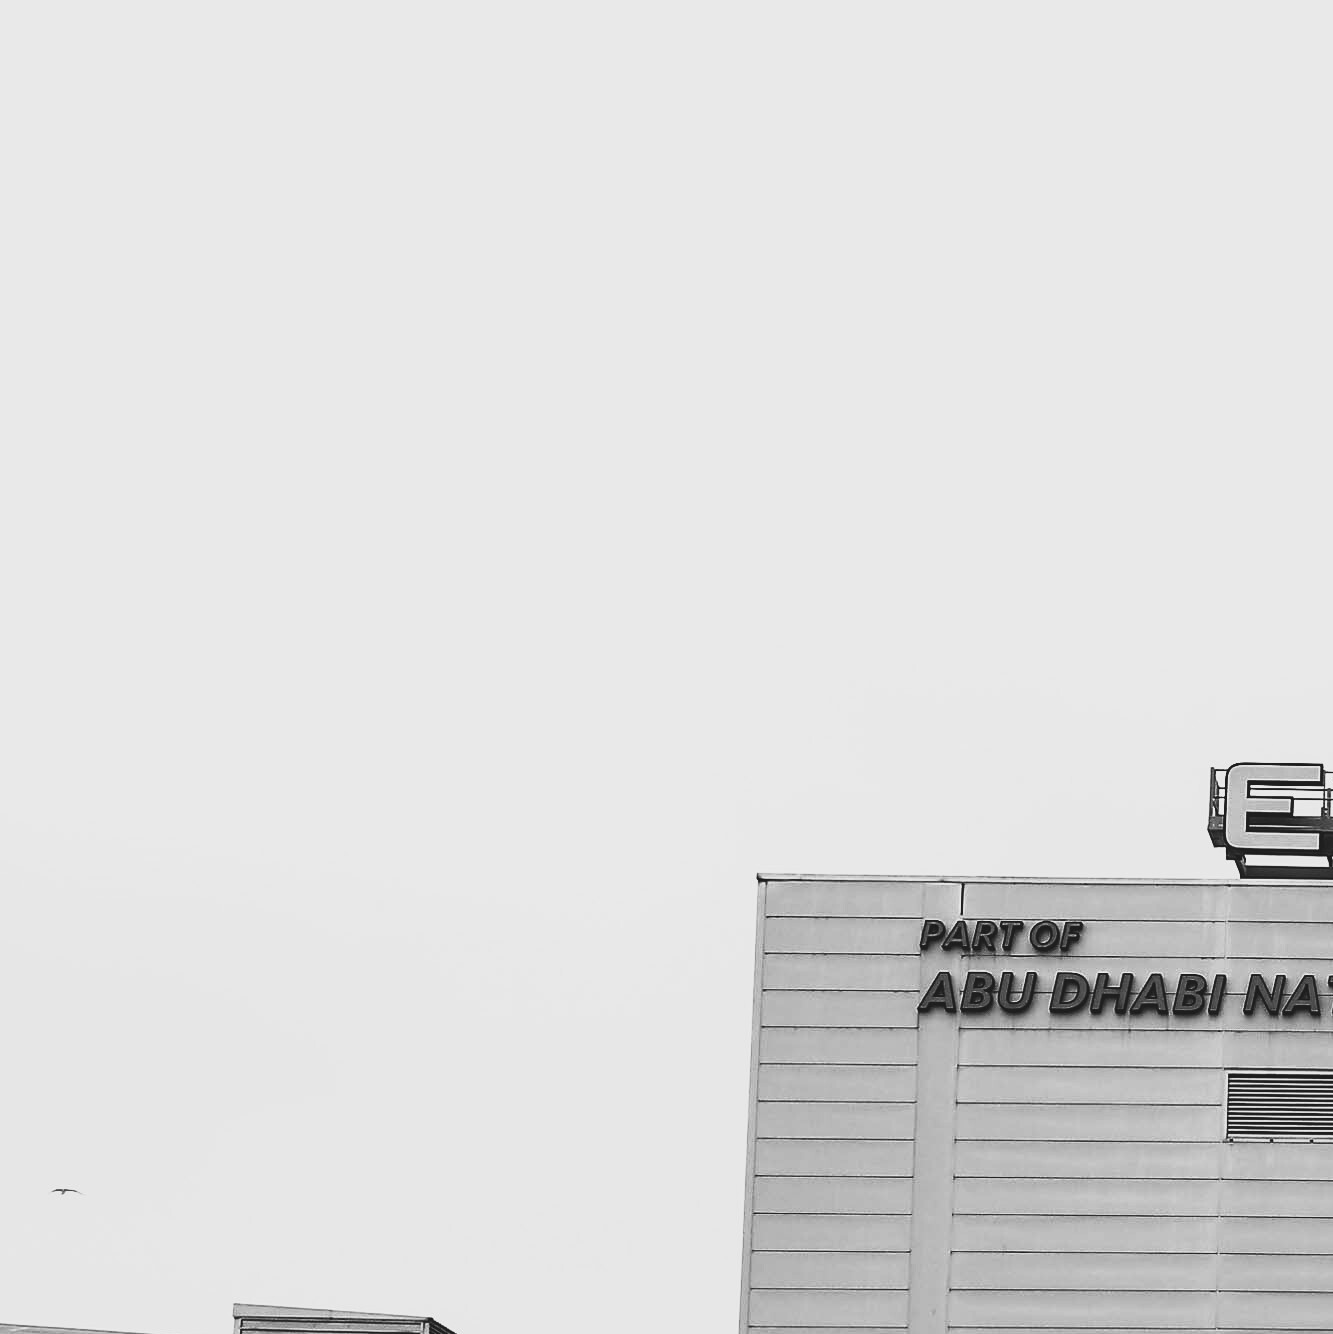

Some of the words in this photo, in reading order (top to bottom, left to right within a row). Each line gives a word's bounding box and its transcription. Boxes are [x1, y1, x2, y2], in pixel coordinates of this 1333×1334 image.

[920, 920, 1023, 951] PART
[1028, 920, 1084, 951] OF
[917, 971, 1035, 1015] ABU
[1048, 972, 1226, 1015] DHABI
